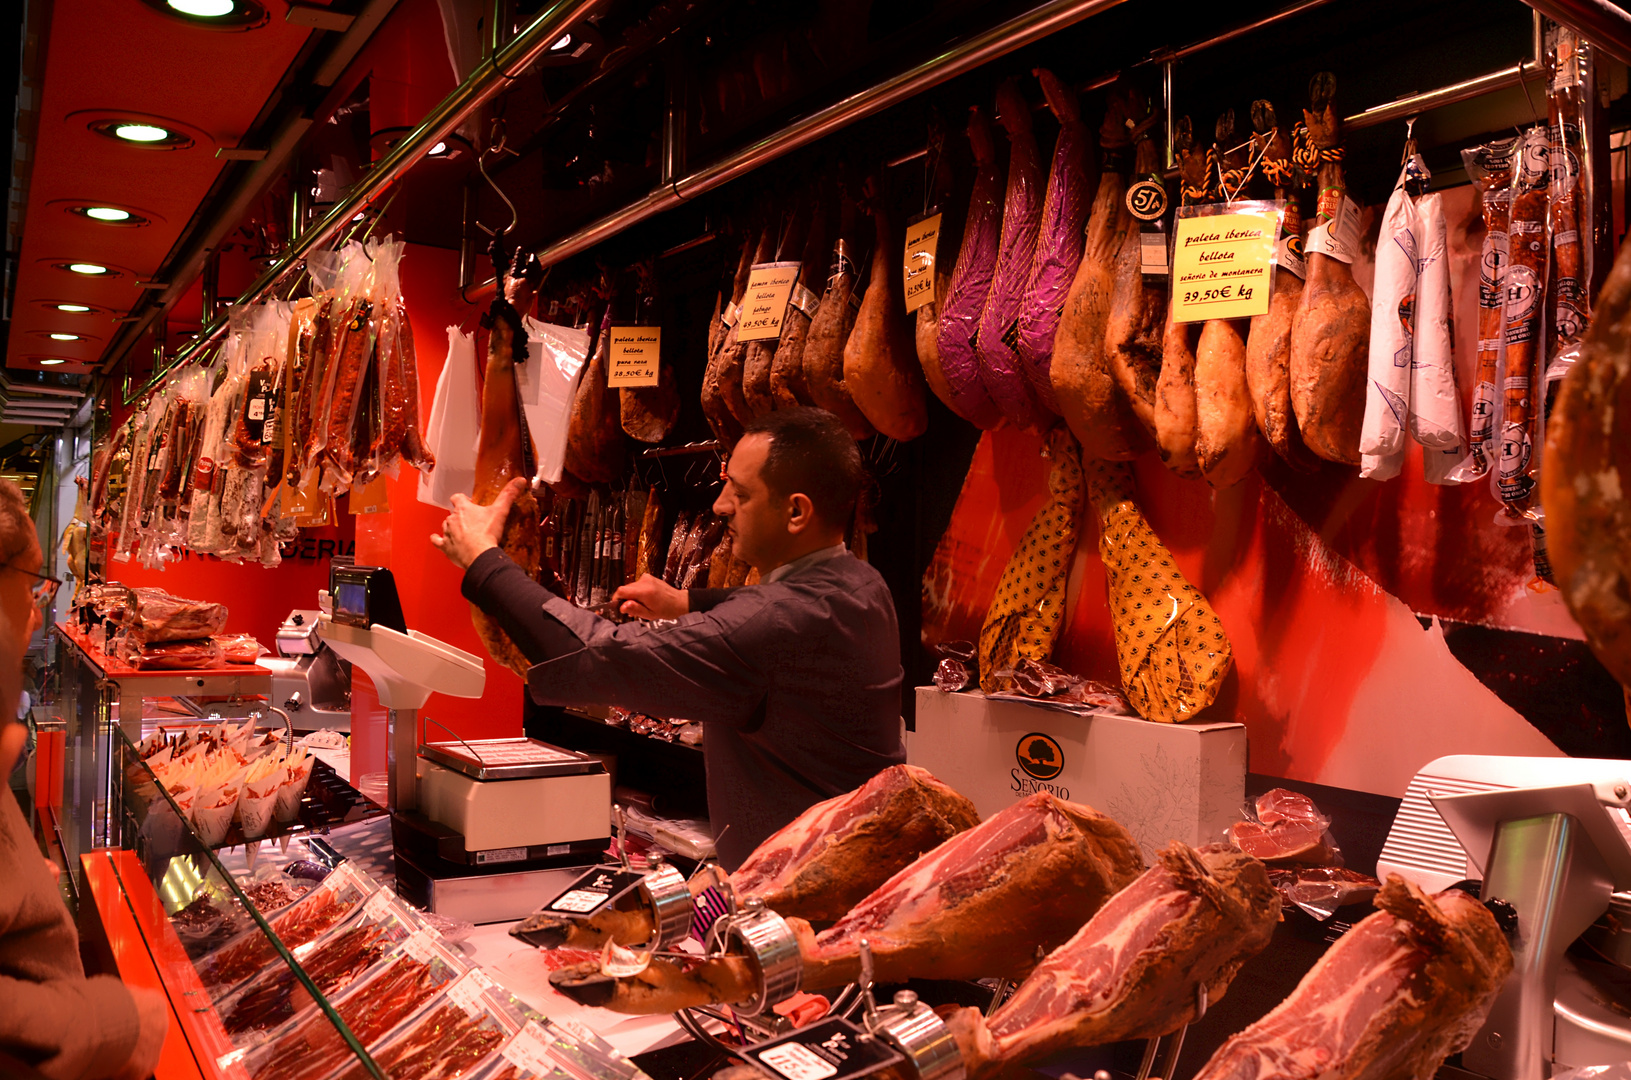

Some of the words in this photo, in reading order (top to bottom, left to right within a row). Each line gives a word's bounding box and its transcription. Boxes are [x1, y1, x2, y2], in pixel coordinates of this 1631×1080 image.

[1185, 232, 1220, 247] paleta
[1225, 229, 1262, 240] iberica
[1199, 251, 1235, 262] bellota
[1180, 273, 1206, 282] señorio
[1209, 270, 1218, 279] de
[1221, 268, 1263, 277] montanera
[1184, 285, 1232, 303] 39,50€
[1237, 284, 1253, 300] kg
[614, 336, 635, 344] paleta
[645, 369, 654, 378] kg
[1010, 767, 1070, 801] SEÑORIO
